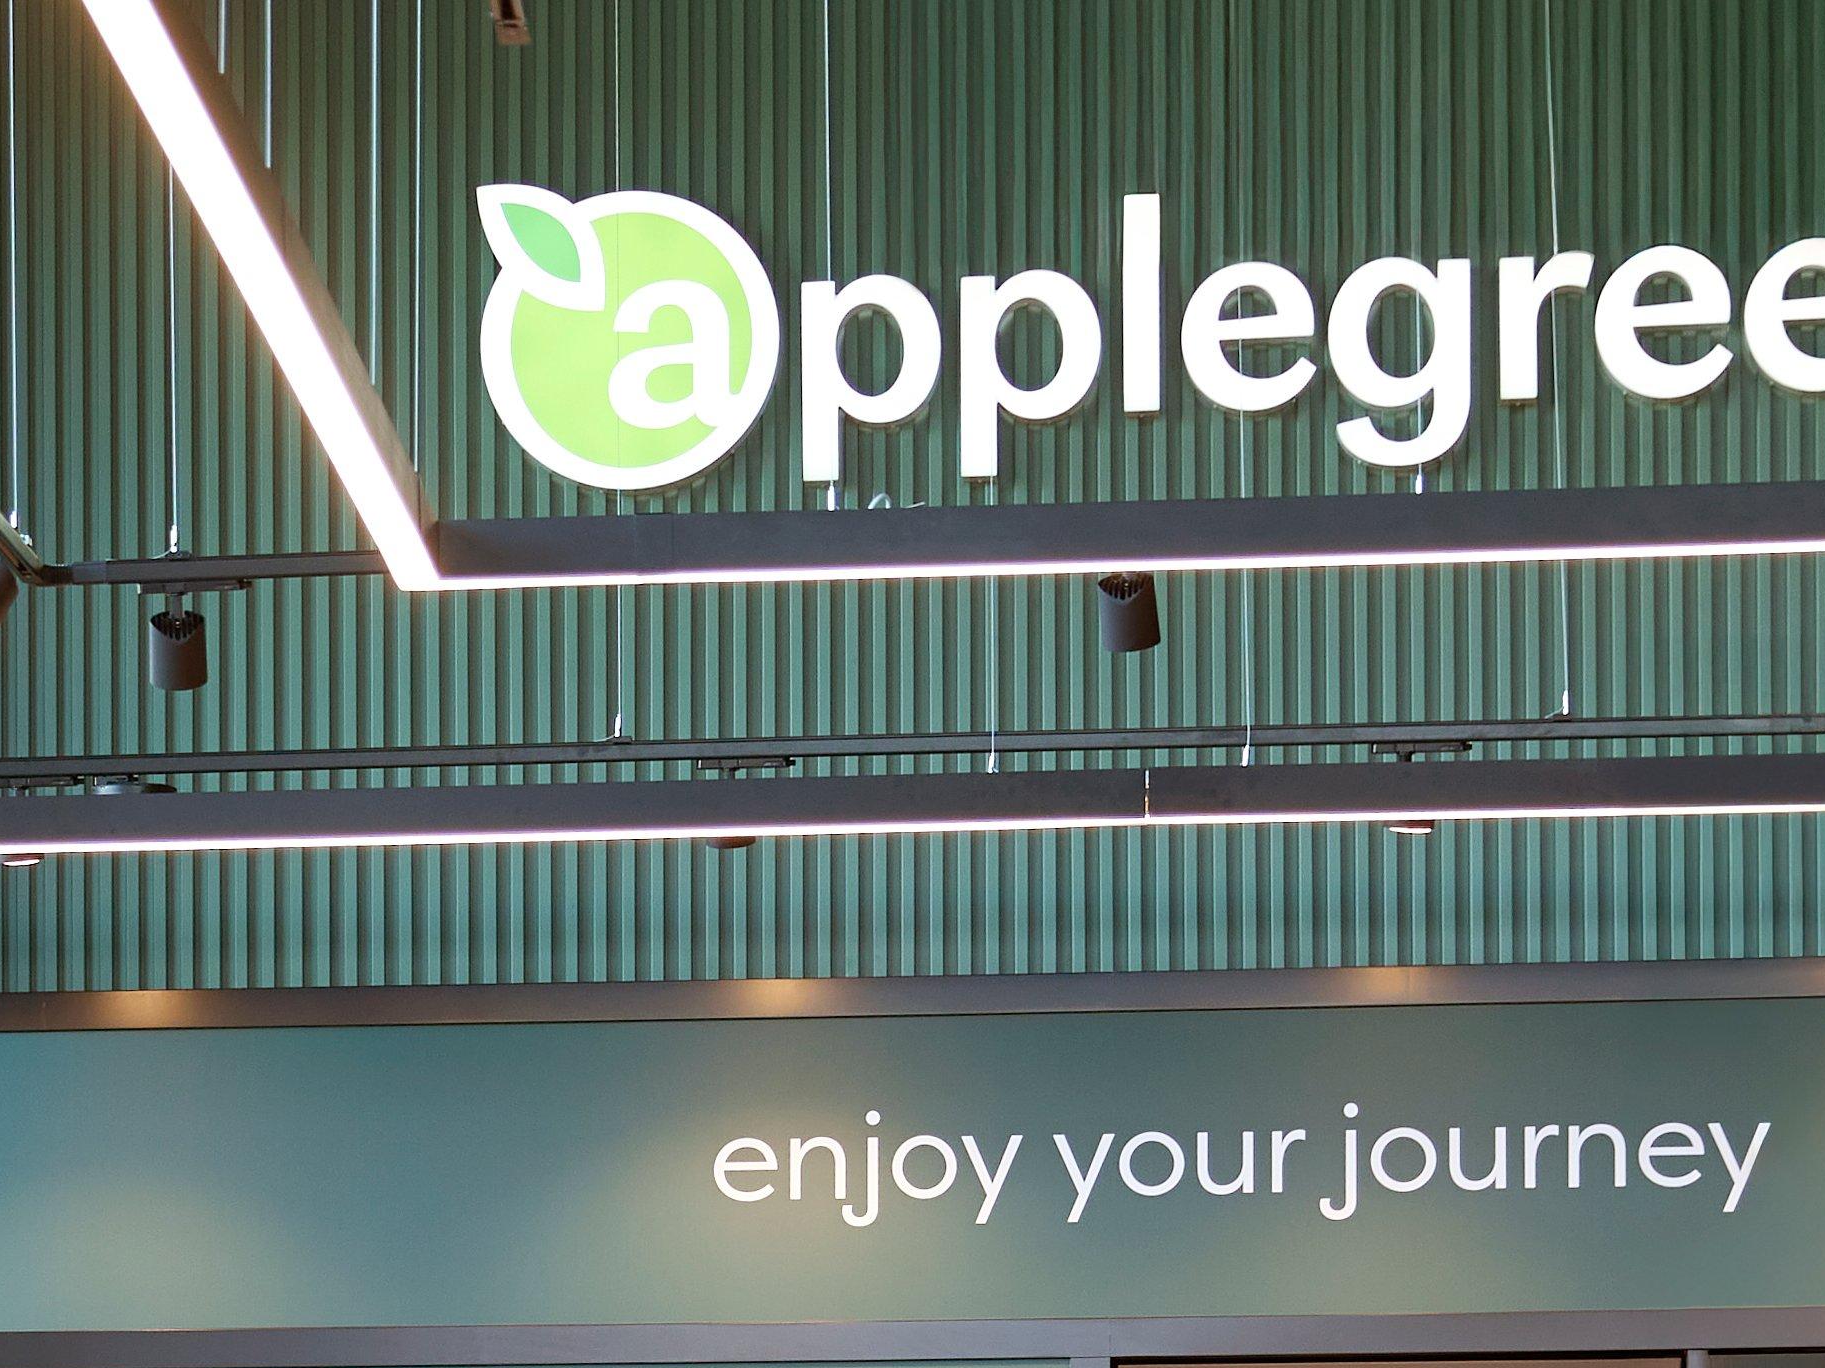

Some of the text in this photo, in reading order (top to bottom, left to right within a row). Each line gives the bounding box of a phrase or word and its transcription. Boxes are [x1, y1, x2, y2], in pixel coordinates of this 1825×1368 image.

[714, 1103, 1770, 1227] enjoy your journey
